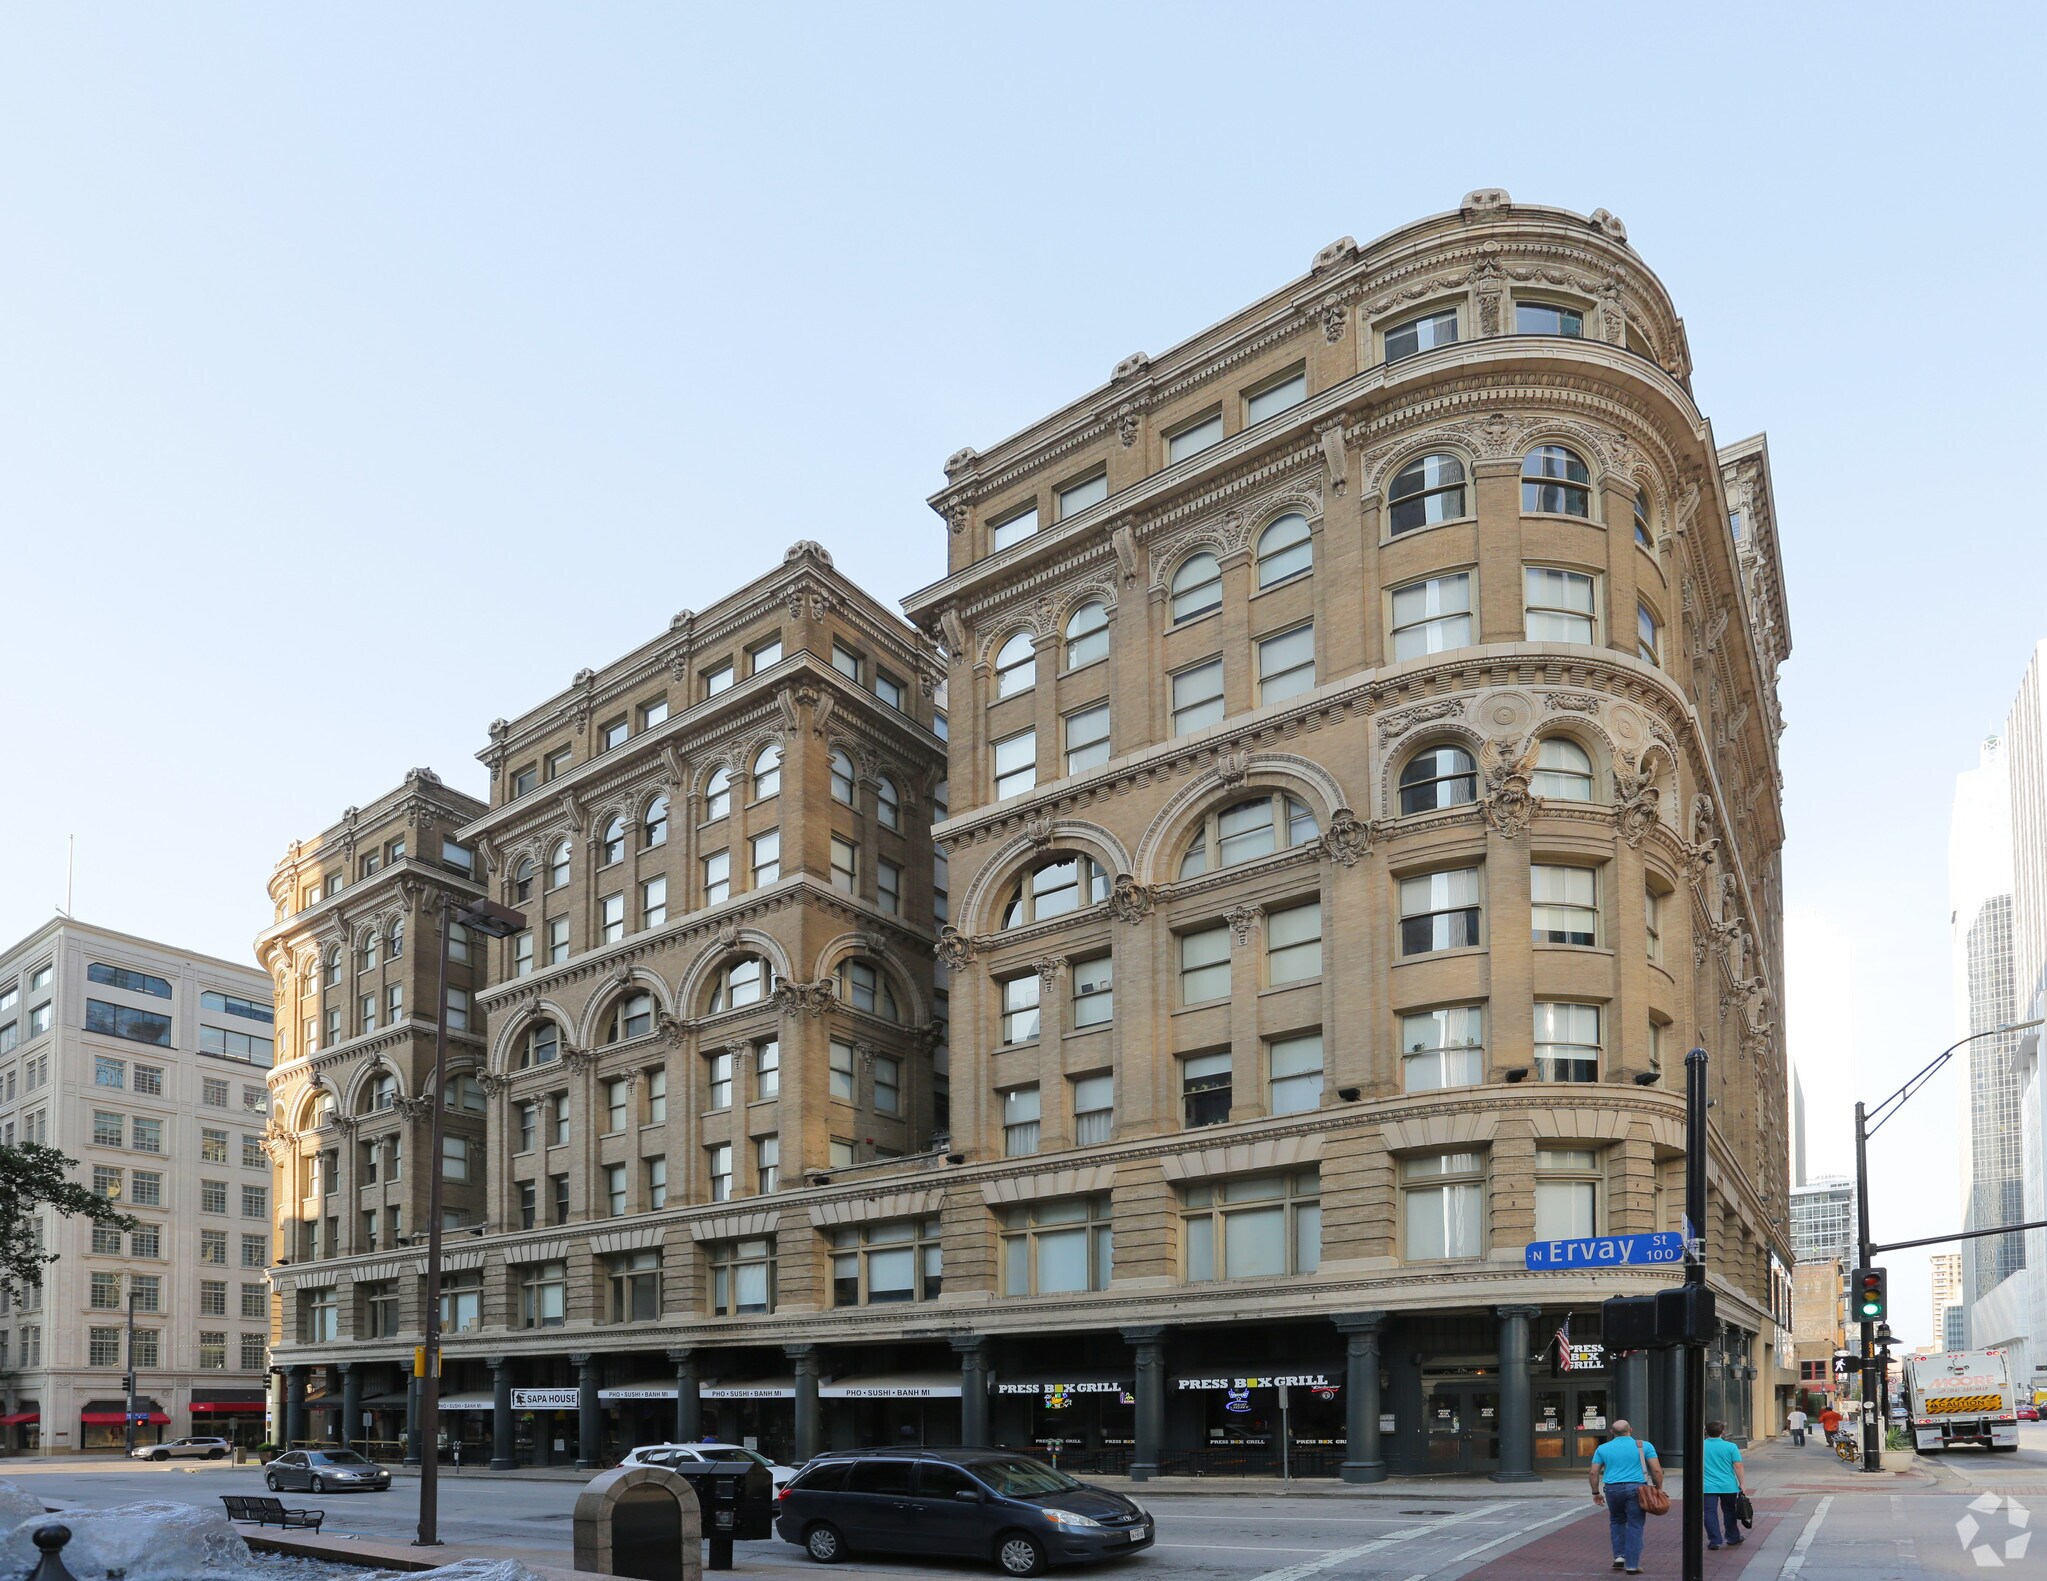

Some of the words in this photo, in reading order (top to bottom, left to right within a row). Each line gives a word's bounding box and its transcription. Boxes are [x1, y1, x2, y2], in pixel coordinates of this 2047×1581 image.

[1533, 1251, 1542, 1261] N
[1549, 1239, 1635, 1264] Ervay
[1653, 1235, 1667, 1246] St
[1646, 1249, 1674, 1261] 100
[1178, 1379, 1228, 1389] PRESS
[1274, 1375, 1328, 1387] GRILL
[1928, 1375, 1994, 1388] MOORE
[998, 1384, 1040, 1394] PRESS
[1077, 1382, 1122, 1392] GRILL
[527, 1394, 547, 1403] SAPA
[548, 1394, 576, 1403] HOUSE
